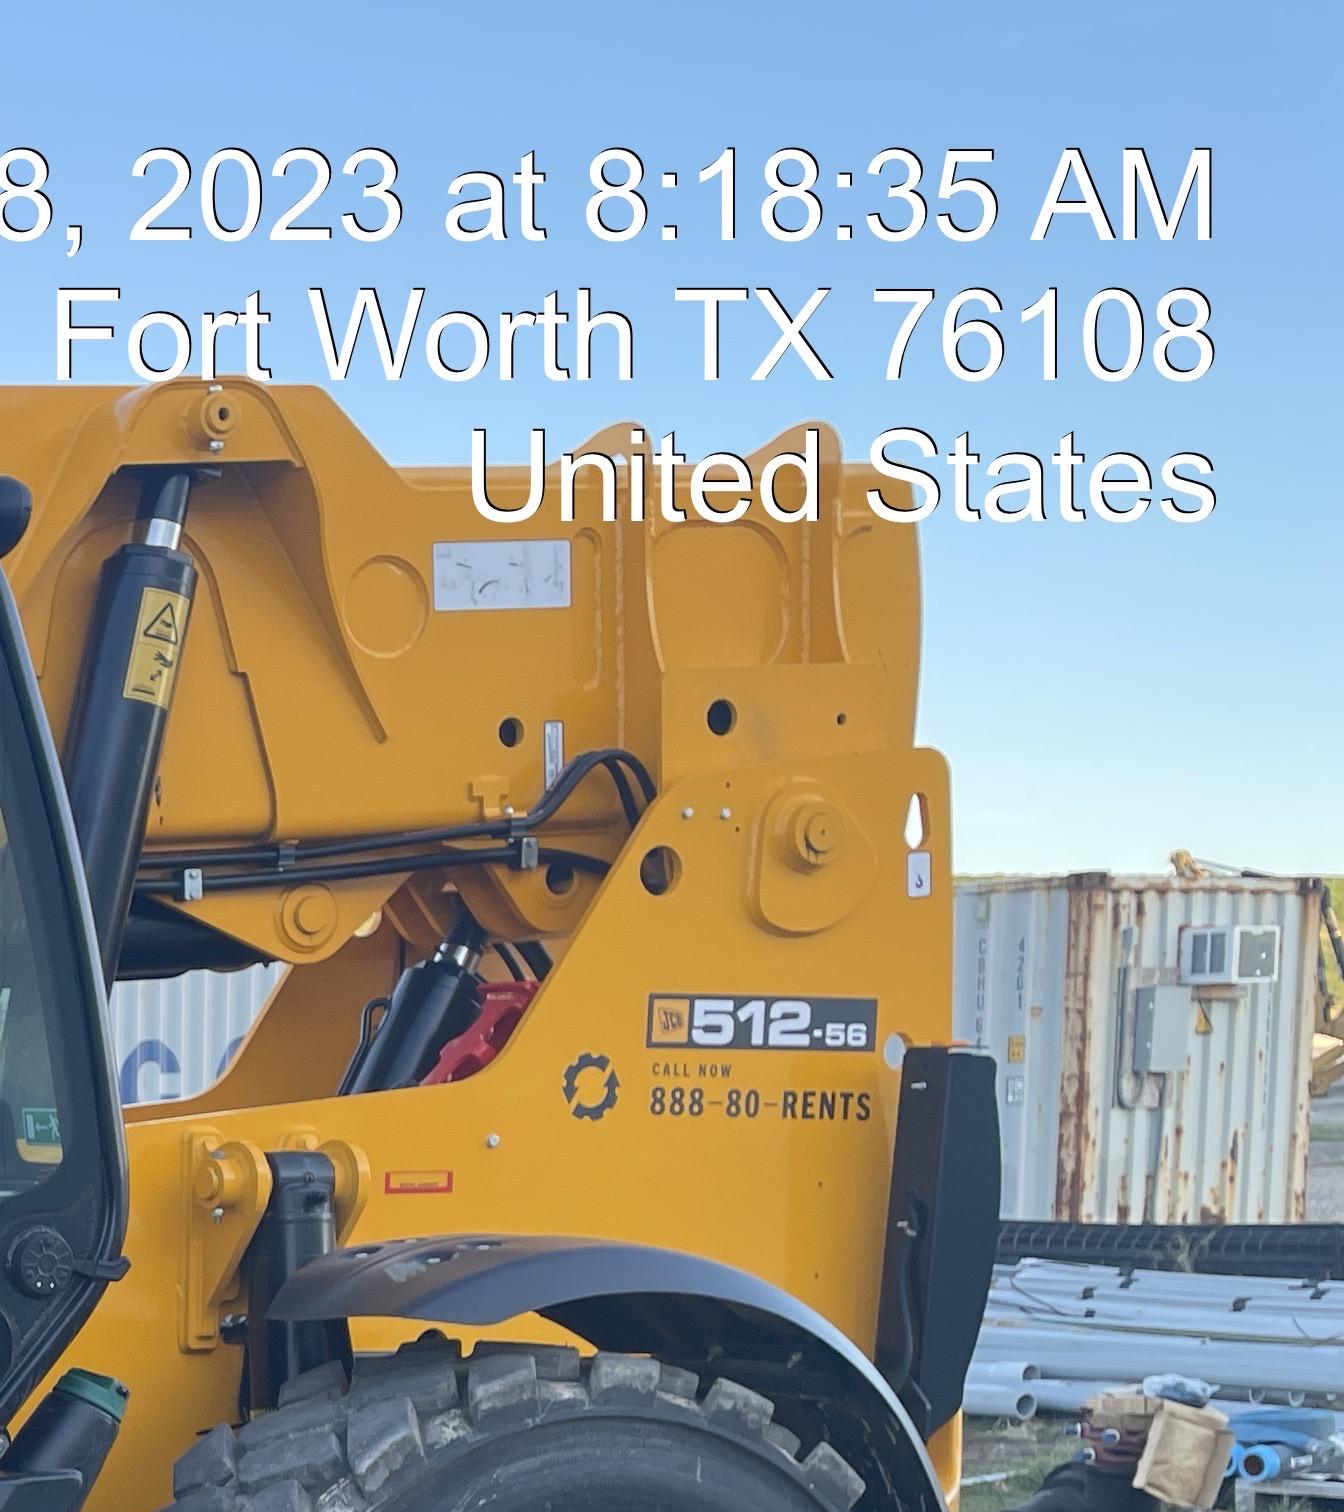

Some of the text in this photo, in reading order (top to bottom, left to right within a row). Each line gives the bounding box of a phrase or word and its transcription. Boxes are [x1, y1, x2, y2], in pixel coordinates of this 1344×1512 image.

[652, 1062, 733, 1078] CALL NOW
[650, 1087, 871, 1121] 888-80-RENTS
